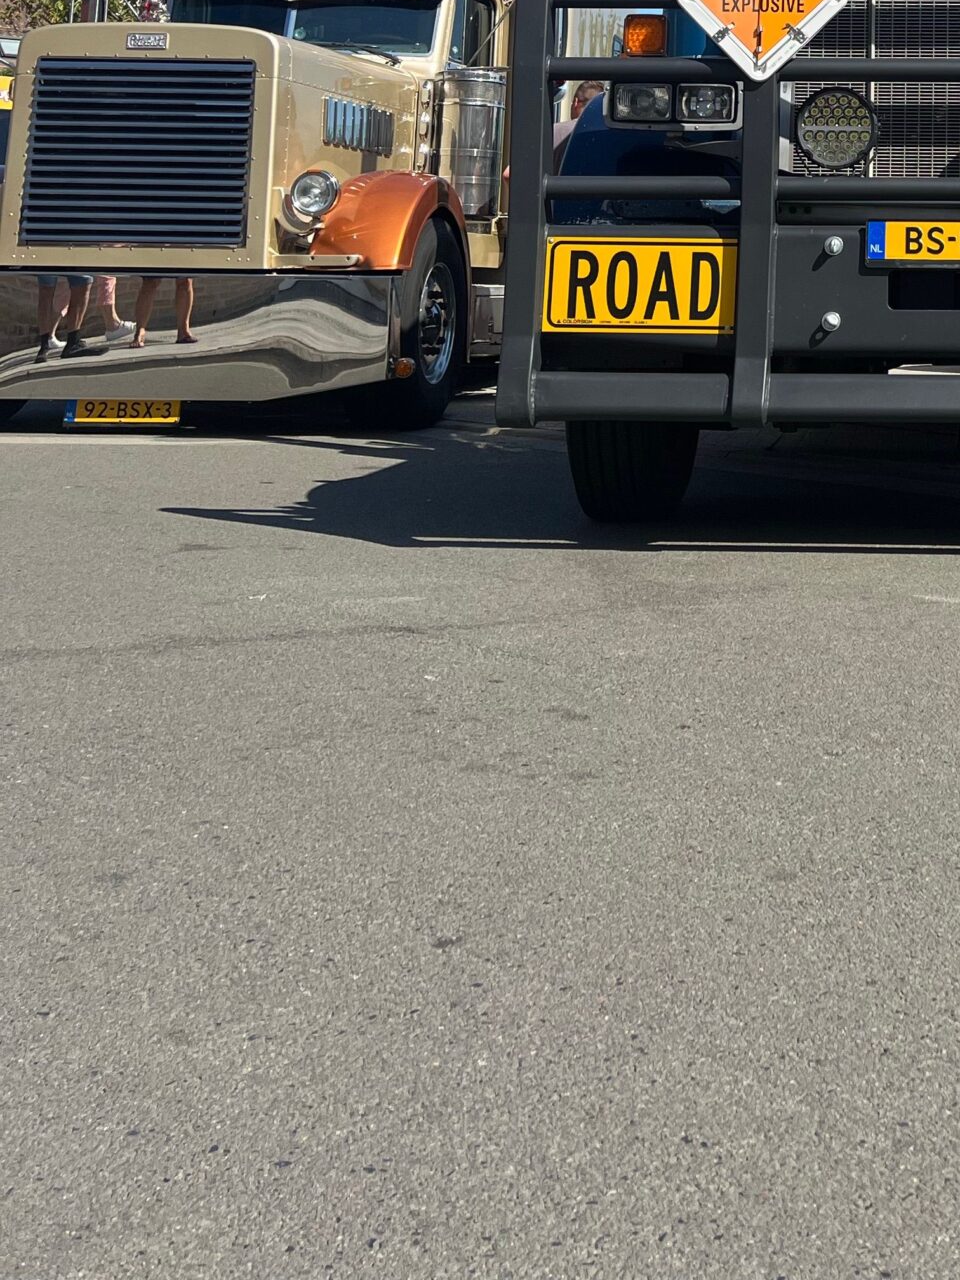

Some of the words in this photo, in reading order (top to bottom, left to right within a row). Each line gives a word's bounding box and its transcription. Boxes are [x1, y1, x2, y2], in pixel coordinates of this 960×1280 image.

[870, 244, 883, 253] NL
[567, 250, 720, 320] ROAD
[84, 401, 173, 419] 92-BSX-3
